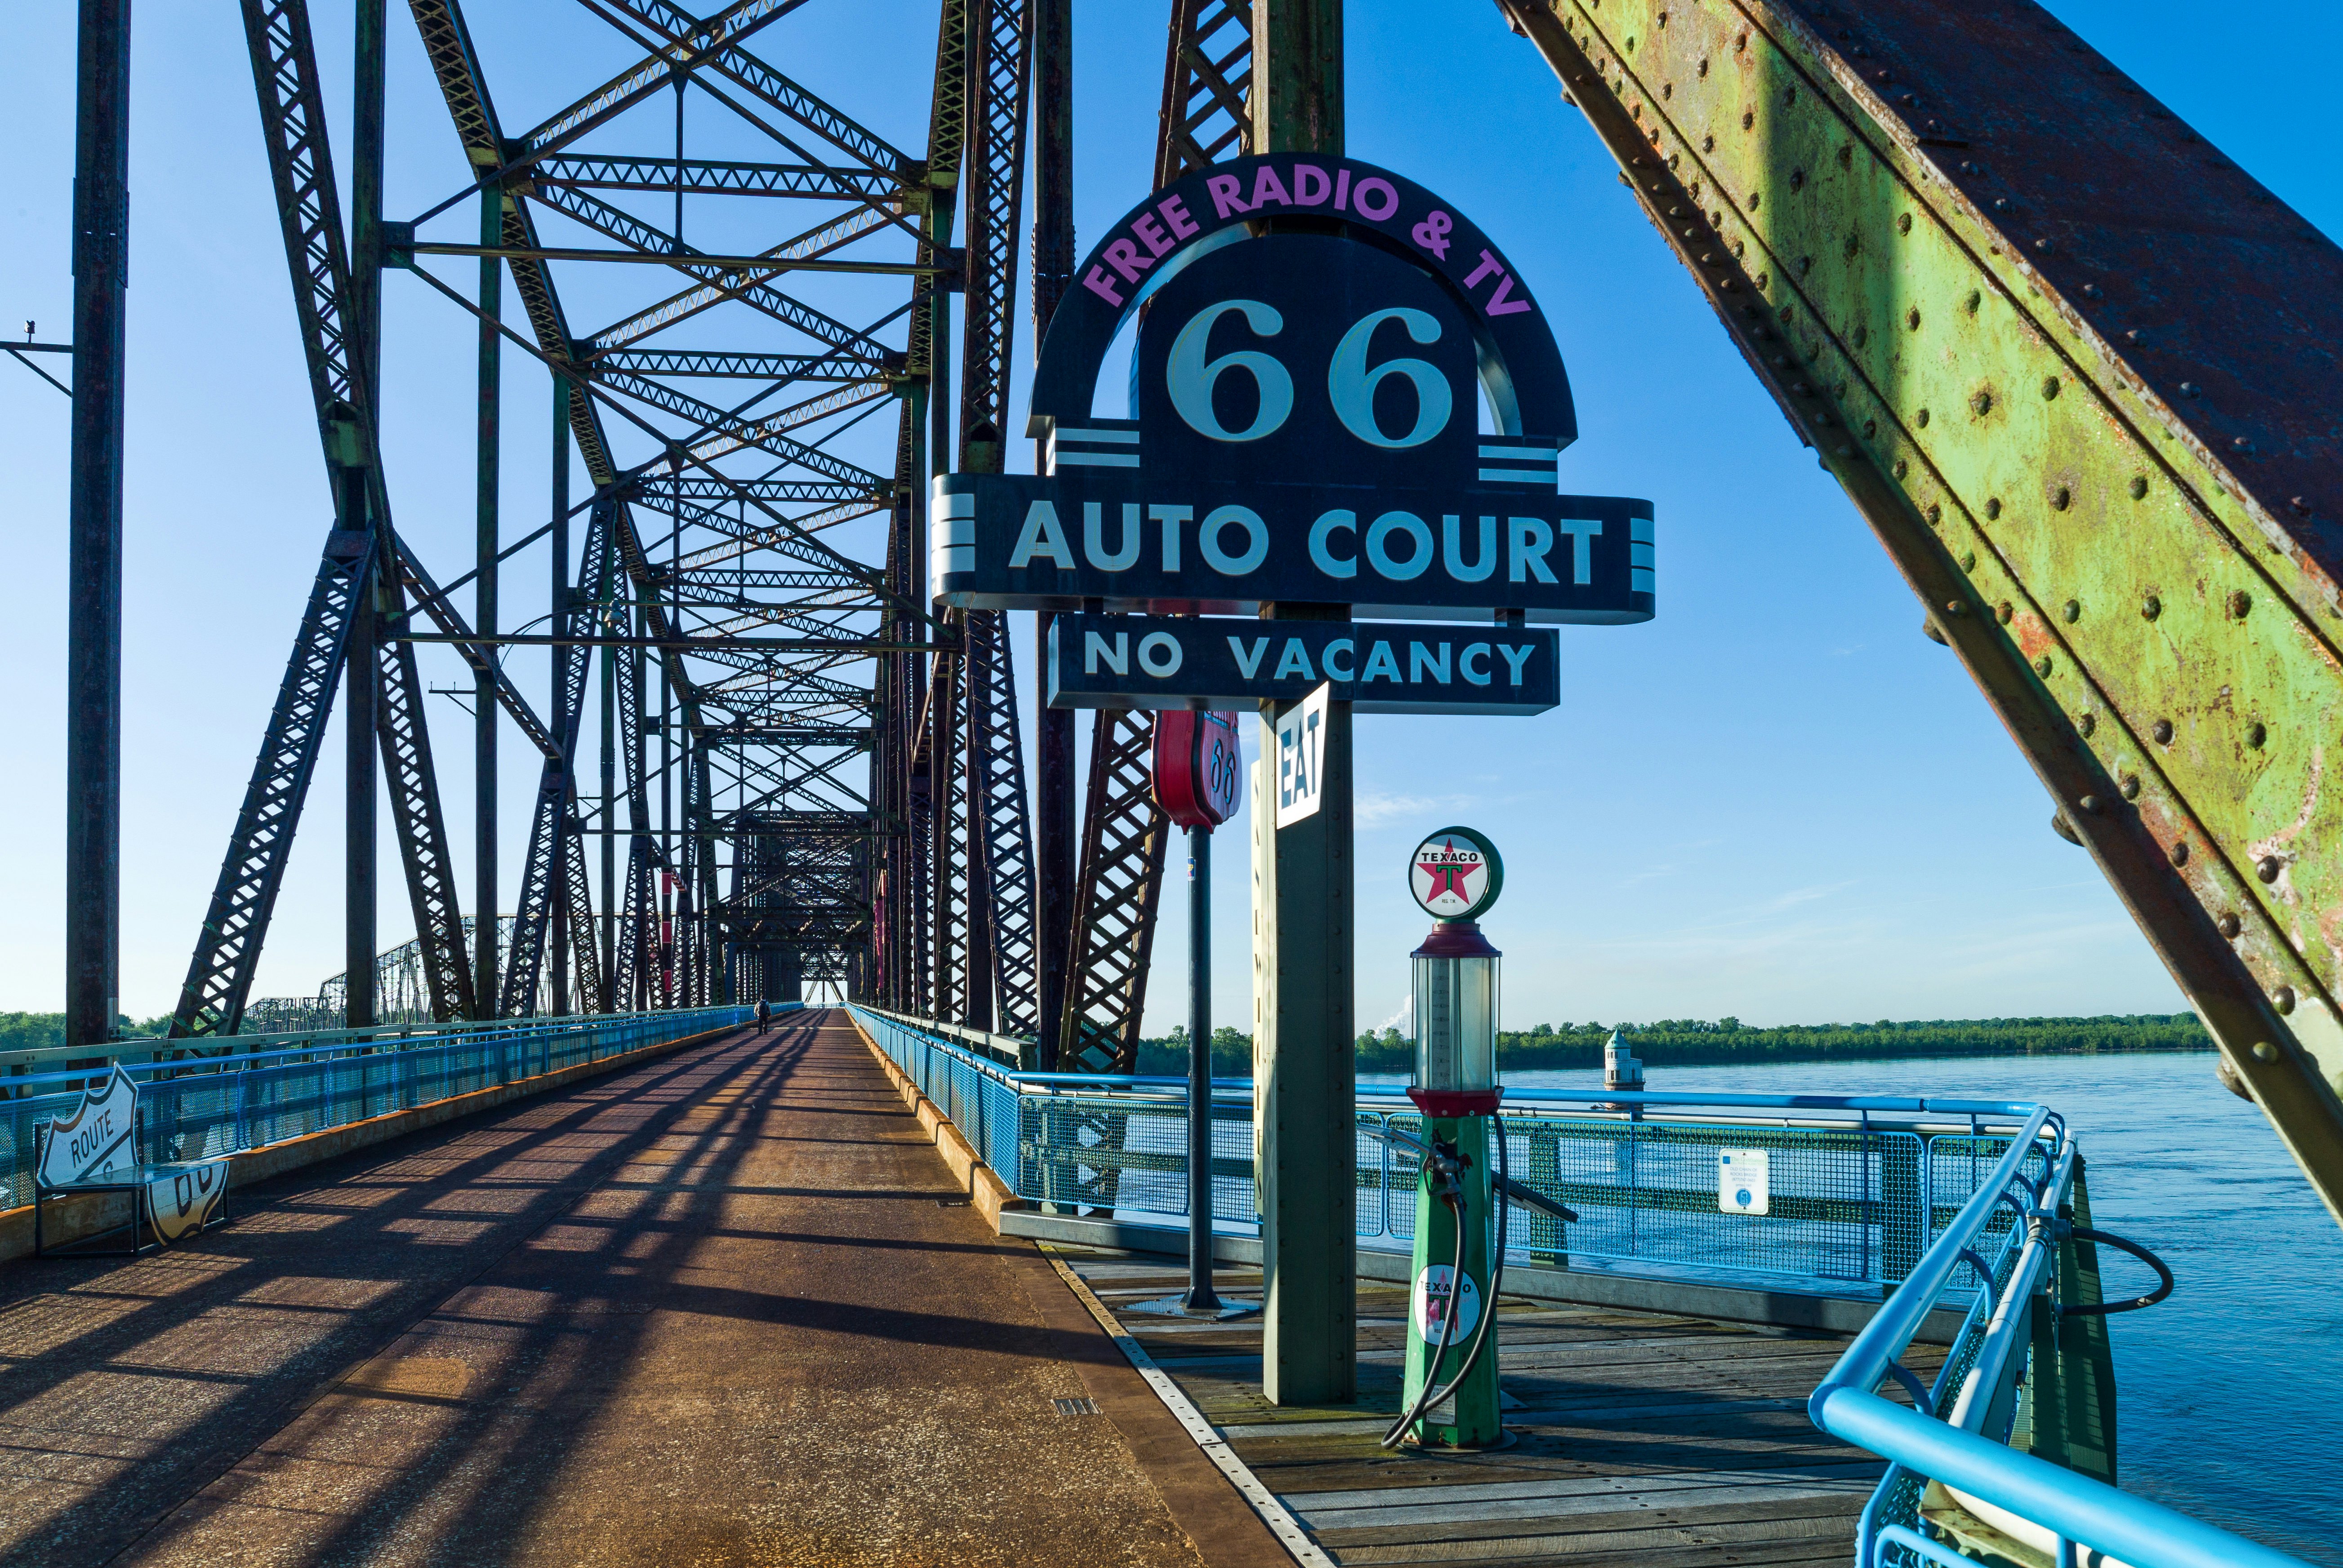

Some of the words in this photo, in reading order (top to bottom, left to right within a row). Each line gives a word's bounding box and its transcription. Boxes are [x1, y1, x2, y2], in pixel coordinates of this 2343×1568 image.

[1084, 195, 1199, 306] FREE
[1207, 164, 1399, 220] RADIO
[1413, 211, 1452, 261] &
[1464, 249, 1531, 316] TV
[1167, 299, 1452, 448] 66
[1008, 500, 1269, 577] AUTO
[1308, 509, 1603, 585] COURT
[1085, 631, 1183, 678] NO
[1227, 636, 1535, 686] VACANCY
[1211, 738, 1236, 804] 66
[1281, 708, 1319, 809] EAT
[1421, 852, 1478, 862] TEXACO
[1436, 865, 1463, 891] T
[71, 1108, 114, 1168] ROUTE
[1421, 1281, 1471, 1293] TEXAO
